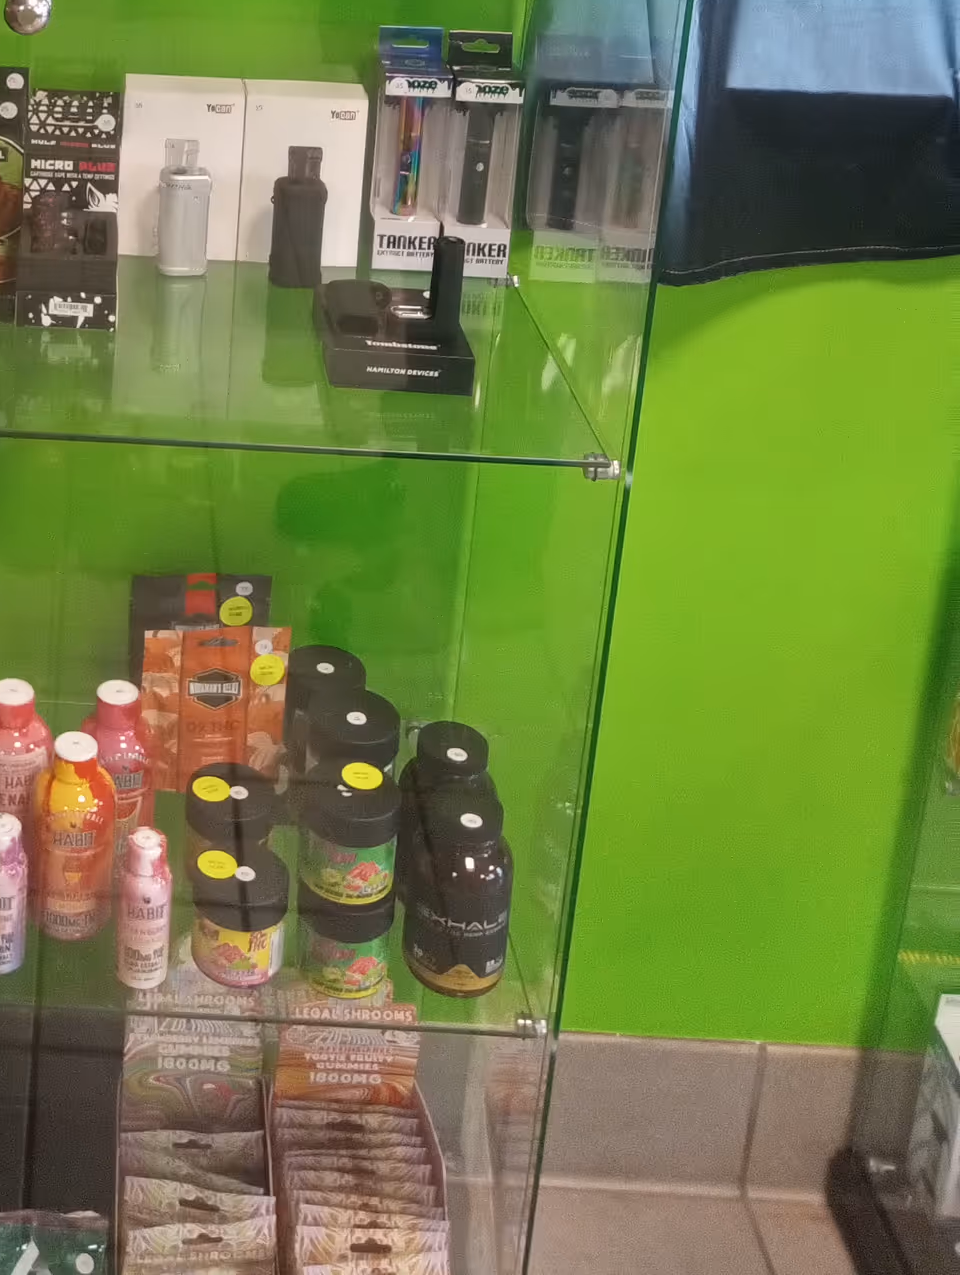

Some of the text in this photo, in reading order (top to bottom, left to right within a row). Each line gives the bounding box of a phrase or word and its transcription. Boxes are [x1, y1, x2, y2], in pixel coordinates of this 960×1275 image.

[30, 158, 74, 171] MICRO
[465, 242, 507, 259] NKER
[366, 365, 439, 378] HAMILTON DEVICES
[295, 1007, 413, 1022] LEGAL SHROOMS
